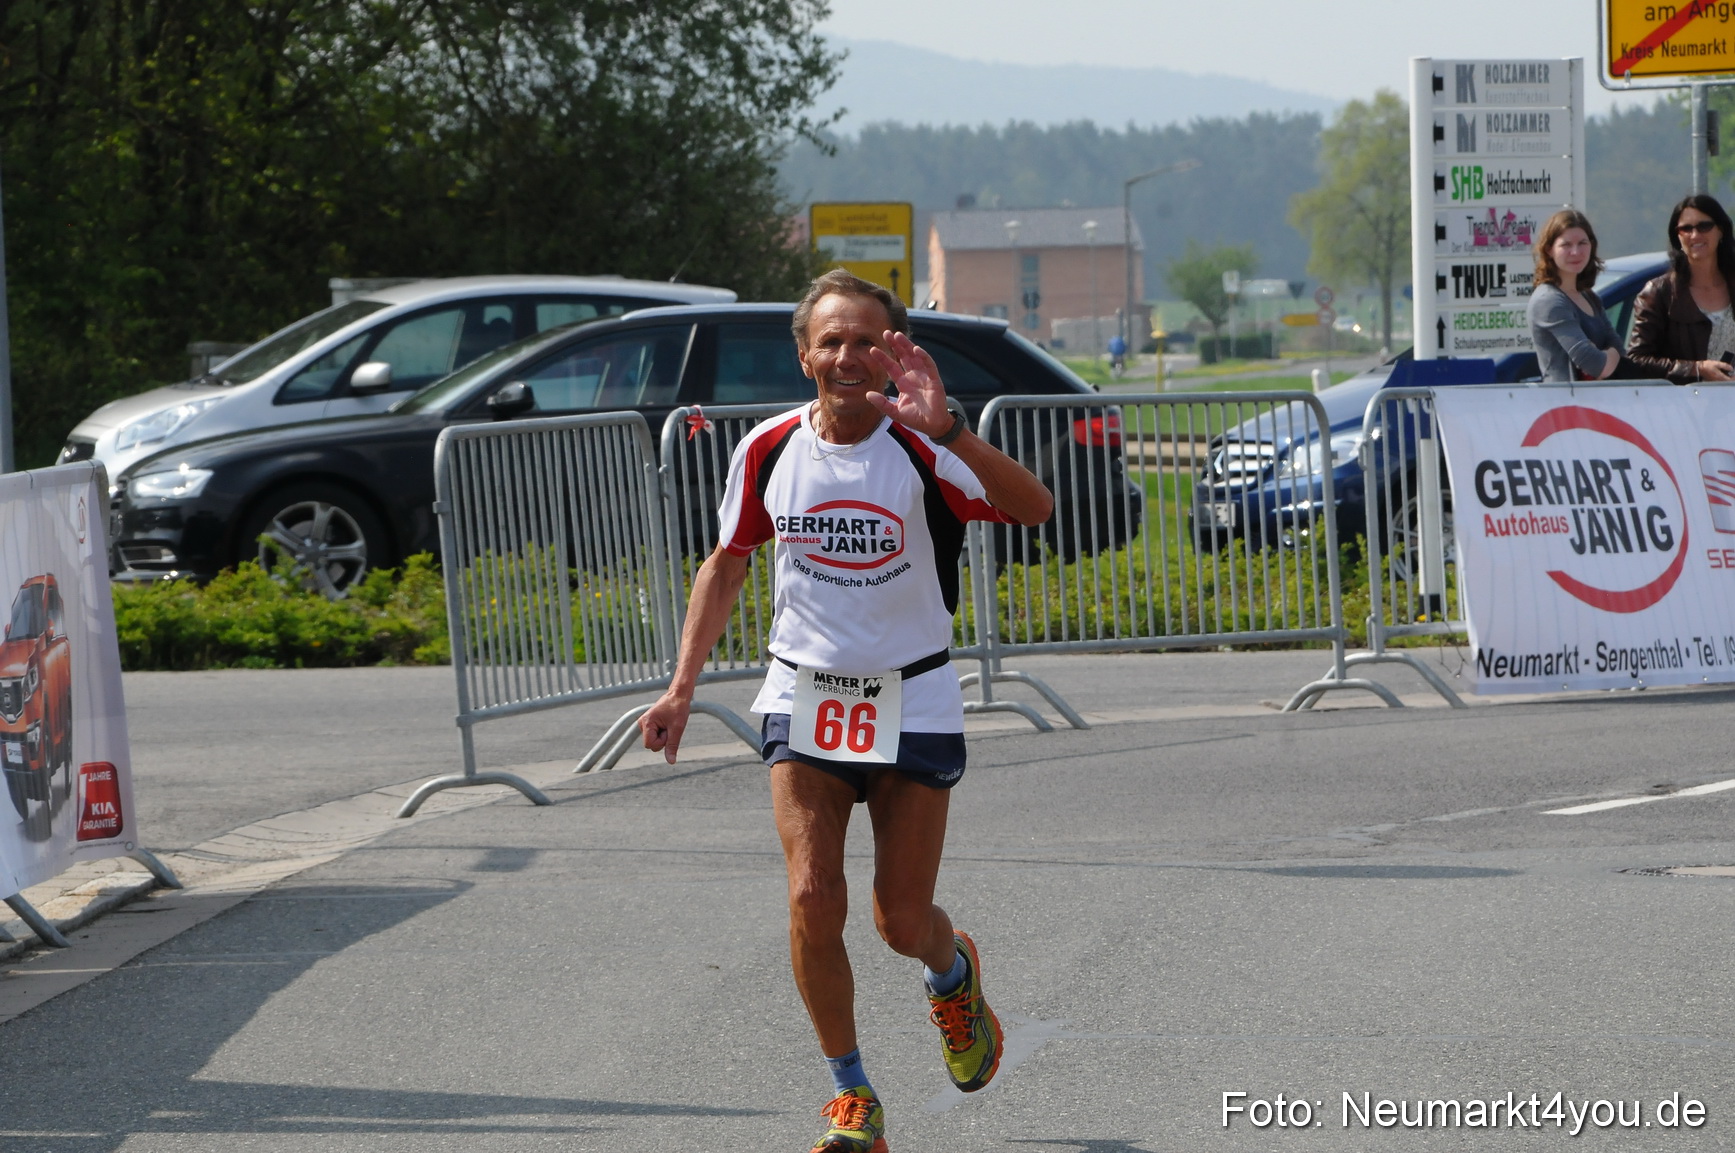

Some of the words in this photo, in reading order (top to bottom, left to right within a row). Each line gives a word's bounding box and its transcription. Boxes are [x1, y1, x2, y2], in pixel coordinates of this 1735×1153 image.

[1644, 5, 1676, 21] am
[1620, 42, 1654, 59] Kreis
[1661, 38, 1727, 57] Neumarkt
[1485, 63, 1550, 84] HOLZAMMER
[1486, 113, 1551, 133] HOLZAMMER
[1451, 166, 1485, 202] SHB
[1487, 169, 1551, 194] Holzfachmarkt
[1451, 263, 1507, 298] THULE
[1454, 338, 1515, 351] Schulungszentrum
[1475, 458, 1635, 508] GERHART
[1640, 467, 1656, 492] &
[776, 515, 881, 536] GERHART
[884, 525, 893, 536] &
[1484, 512, 1569, 538] Autohaus
[1569, 505, 1675, 556] JÄNIG
[779, 534, 822, 544] Autohaus
[821, 536, 897, 554] JÄNIG
[793, 558, 811, 576] Das
[812, 570, 863, 588] sportliche
[865, 561, 912, 587] Autohaus
[1477, 644, 1580, 678] Neumarkt
[1596, 637, 1684, 679] Sengenthal
[1693, 637, 1722, 667] Tel.
[813, 671, 860, 688] MEYER
[813, 682, 860, 697] WERBUNG
[814, 699, 877, 754] 66
[88, 770, 112, 783] JAHRE
[91, 801, 116, 816] KIA
[83, 817, 117, 831] GARANTIE
